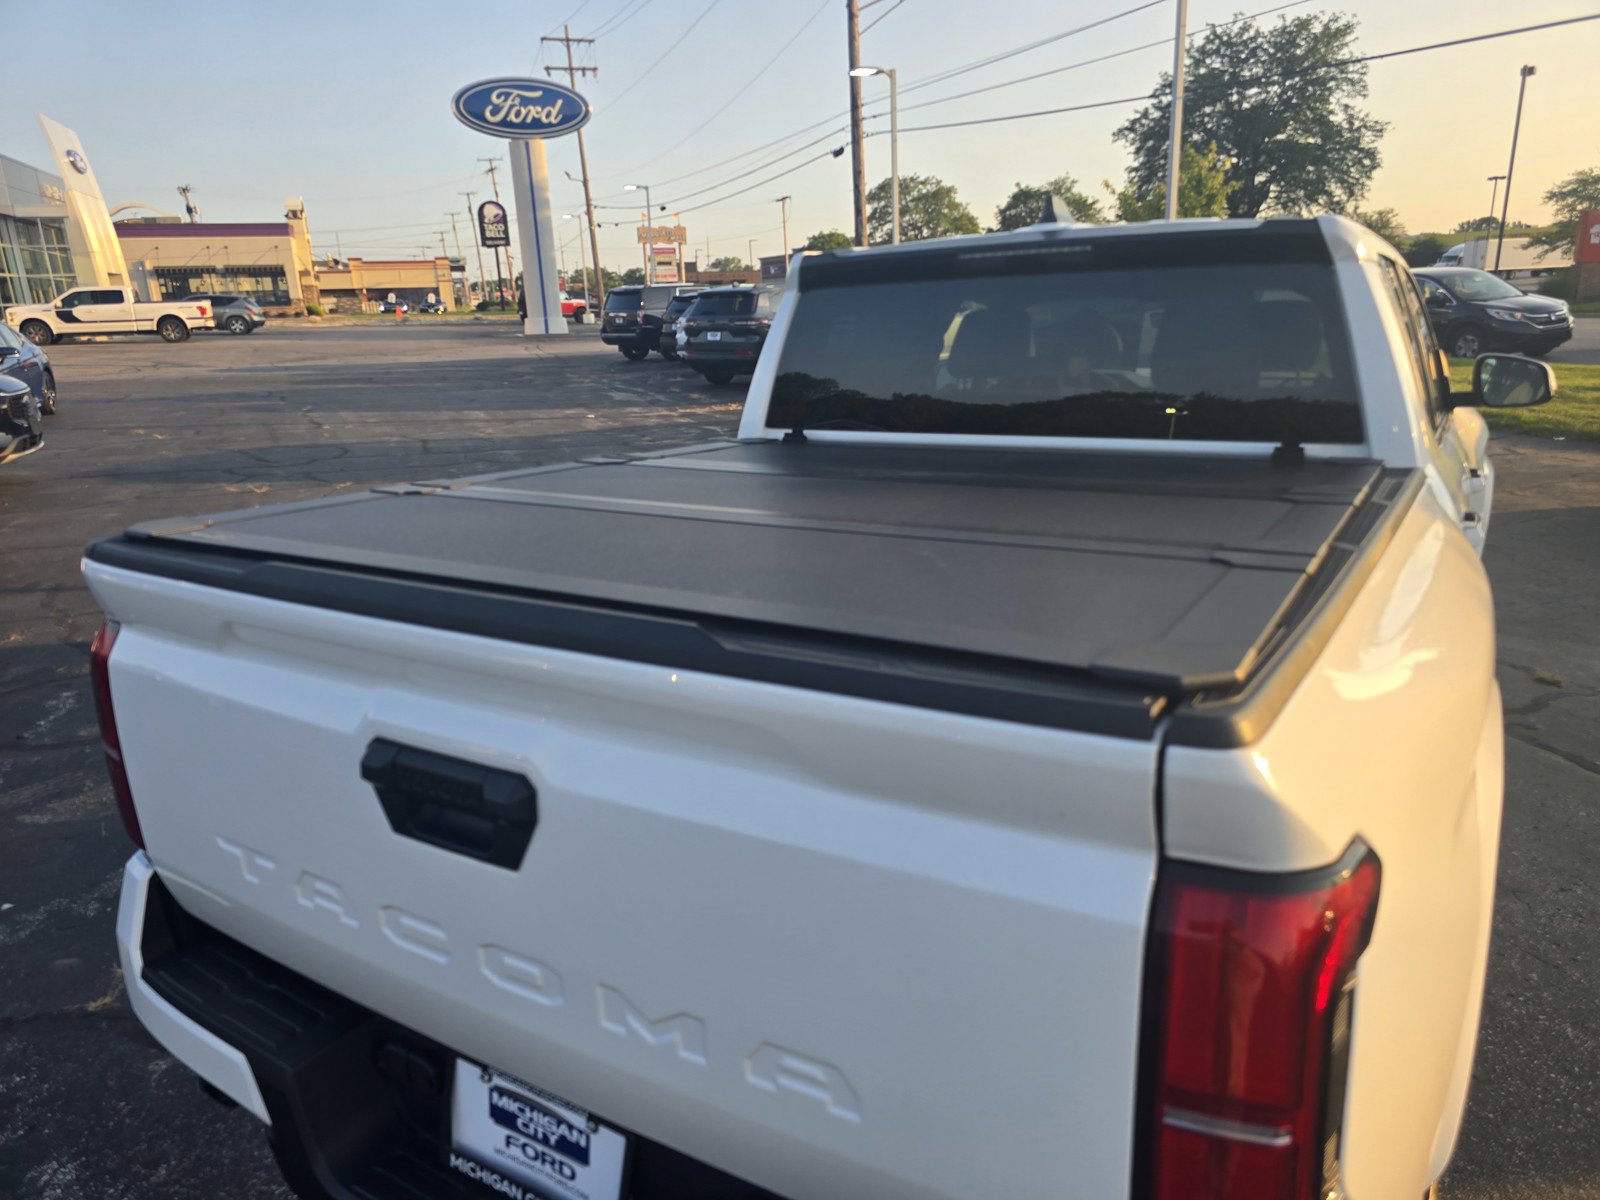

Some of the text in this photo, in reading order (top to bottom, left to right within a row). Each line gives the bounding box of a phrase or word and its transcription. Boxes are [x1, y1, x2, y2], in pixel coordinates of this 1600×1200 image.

[484, 87, 564, 125] Ford
[483, 222, 506, 231] TACO
[485, 229, 506, 238] BELL
[214, 835, 862, 1124] TACOMA
[491, 1090, 588, 1149] MICHIGAN
[516, 1117, 561, 1146] CITY
[449, 1152, 523, 1200] MICHIGAN
[504, 1134, 577, 1181] FORD
